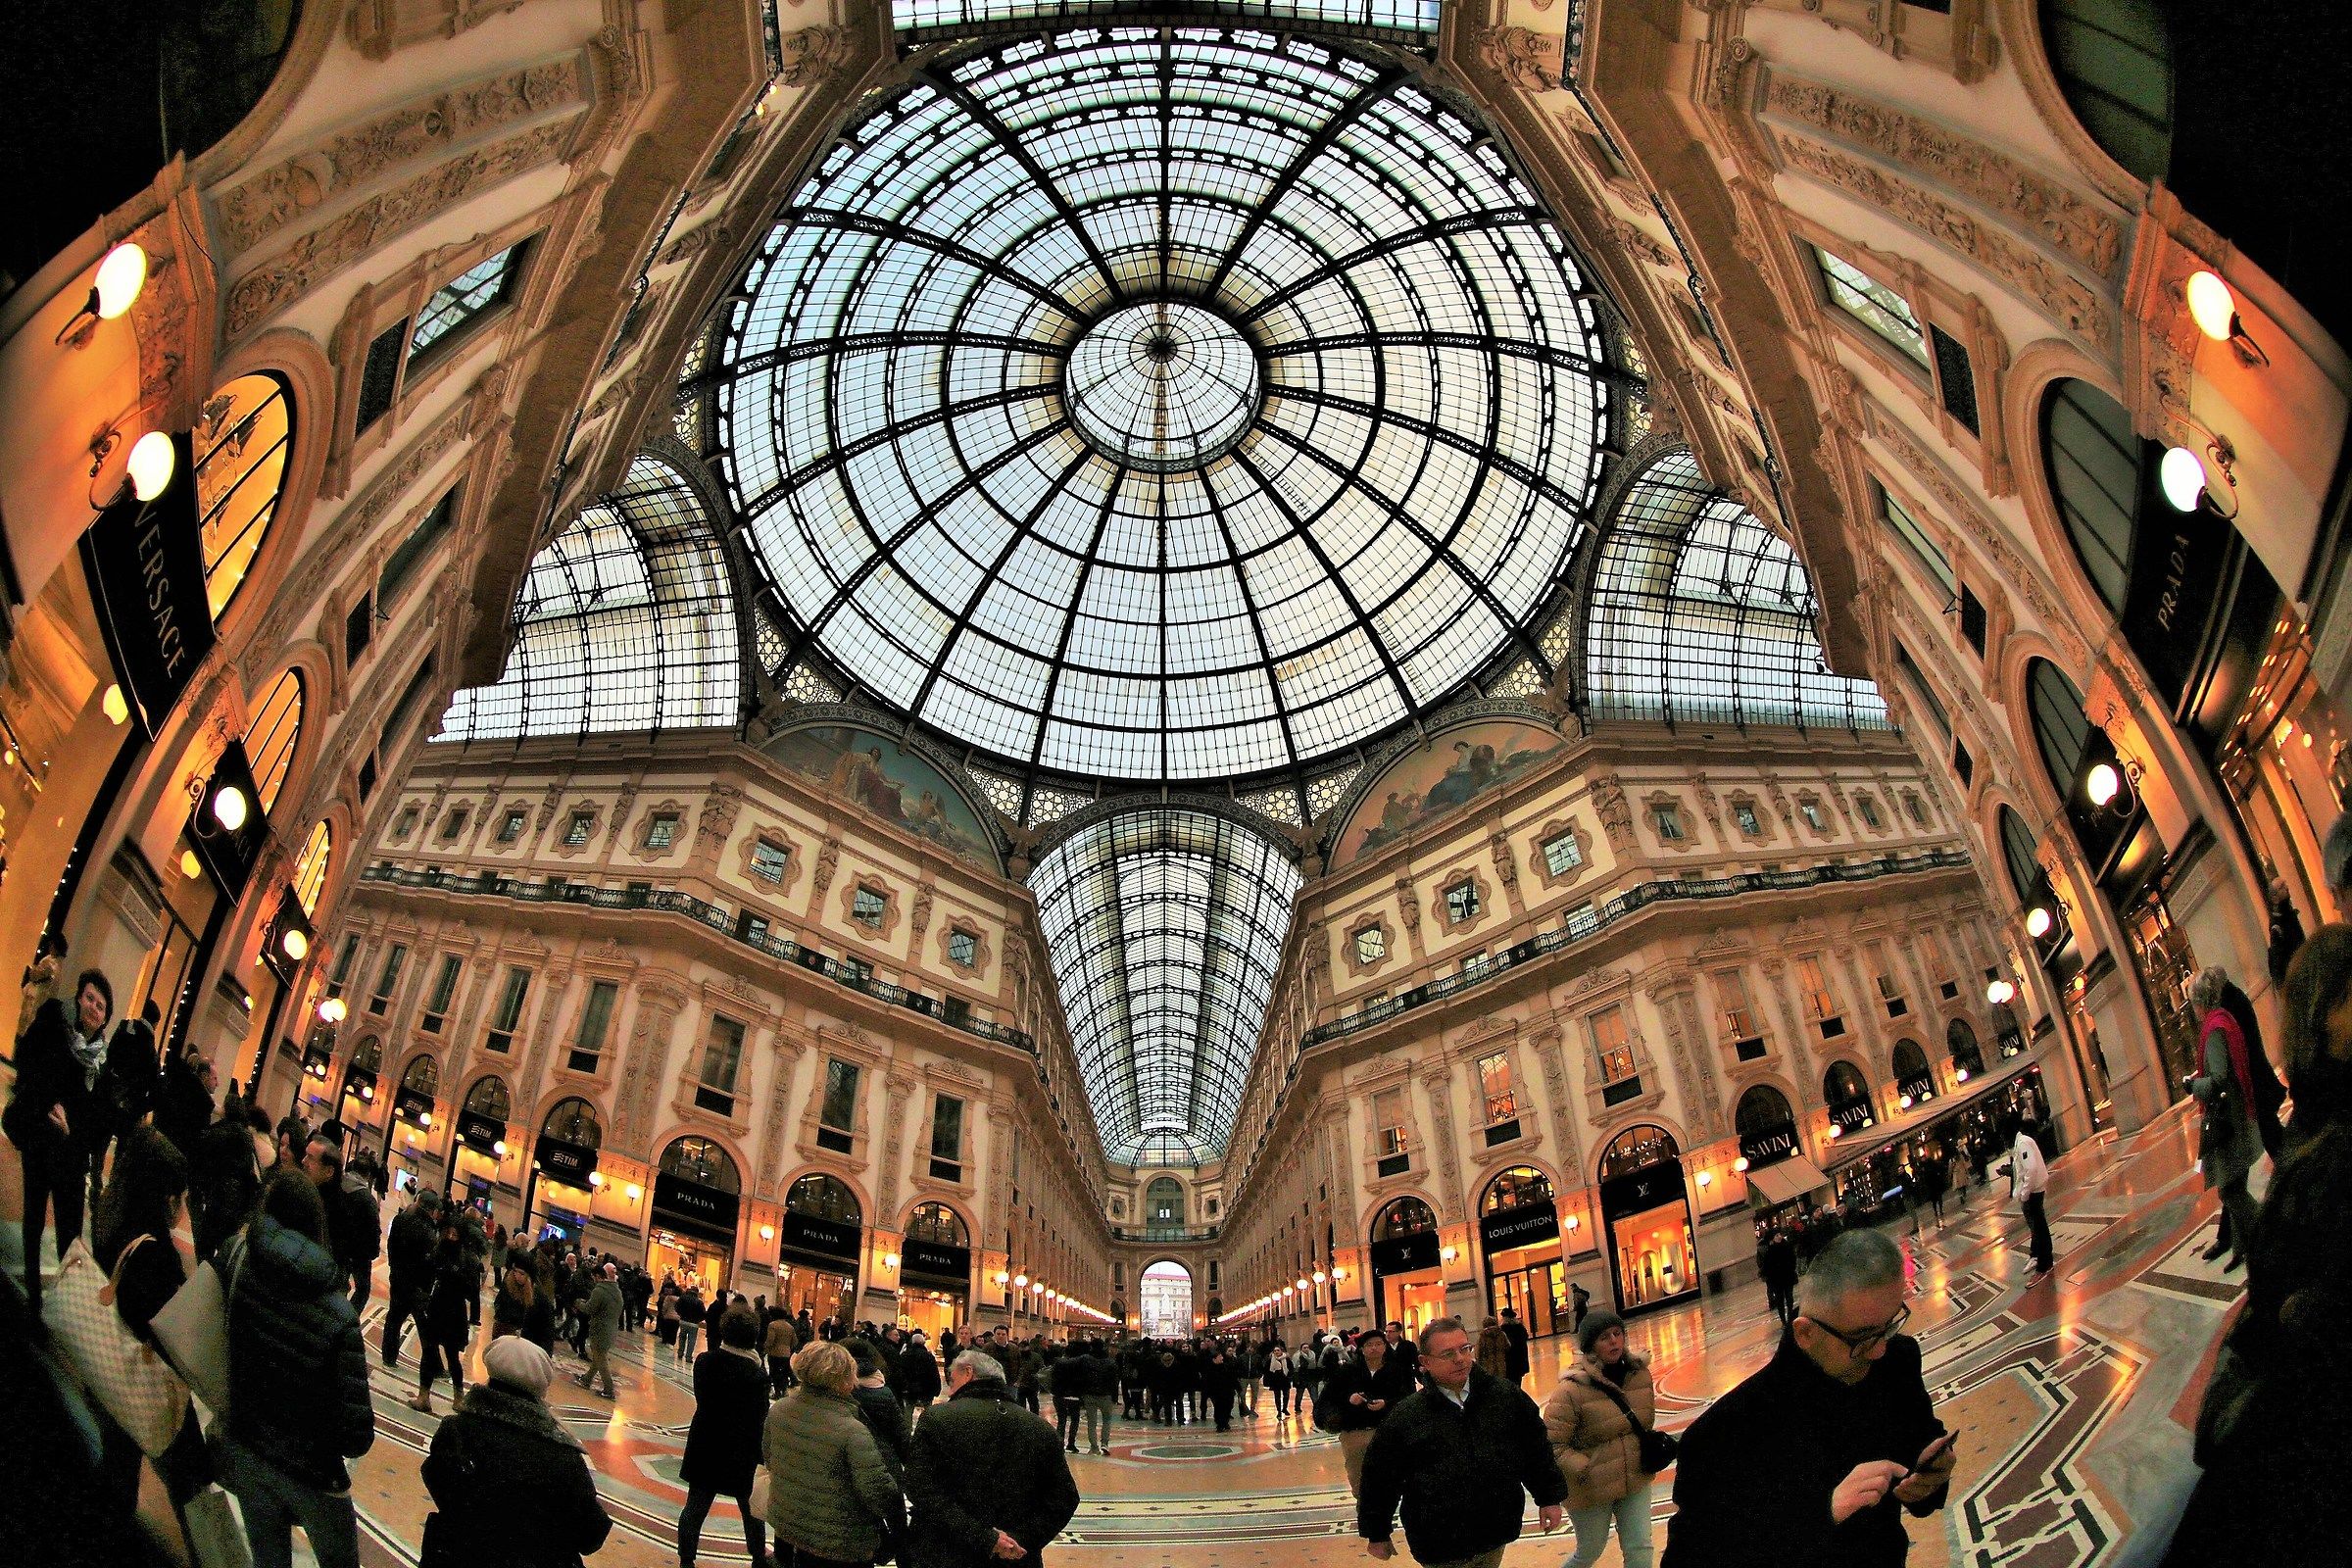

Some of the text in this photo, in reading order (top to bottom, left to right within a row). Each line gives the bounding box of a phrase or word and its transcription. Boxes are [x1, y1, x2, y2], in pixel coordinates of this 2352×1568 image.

[134, 498, 186, 678] VERSACE
[2158, 534, 2189, 632] PRADA
[1833, 1103, 1868, 1126] SAVINI
[1745, 1133, 1791, 1160] SAVINI
[677, 1192, 715, 1210] PRADA
[804, 1228, 839, 1244] PRADA
[1489, 1214, 1552, 1239] LOUIS VUITTON
[919, 1253, 952, 1265] PRADA
